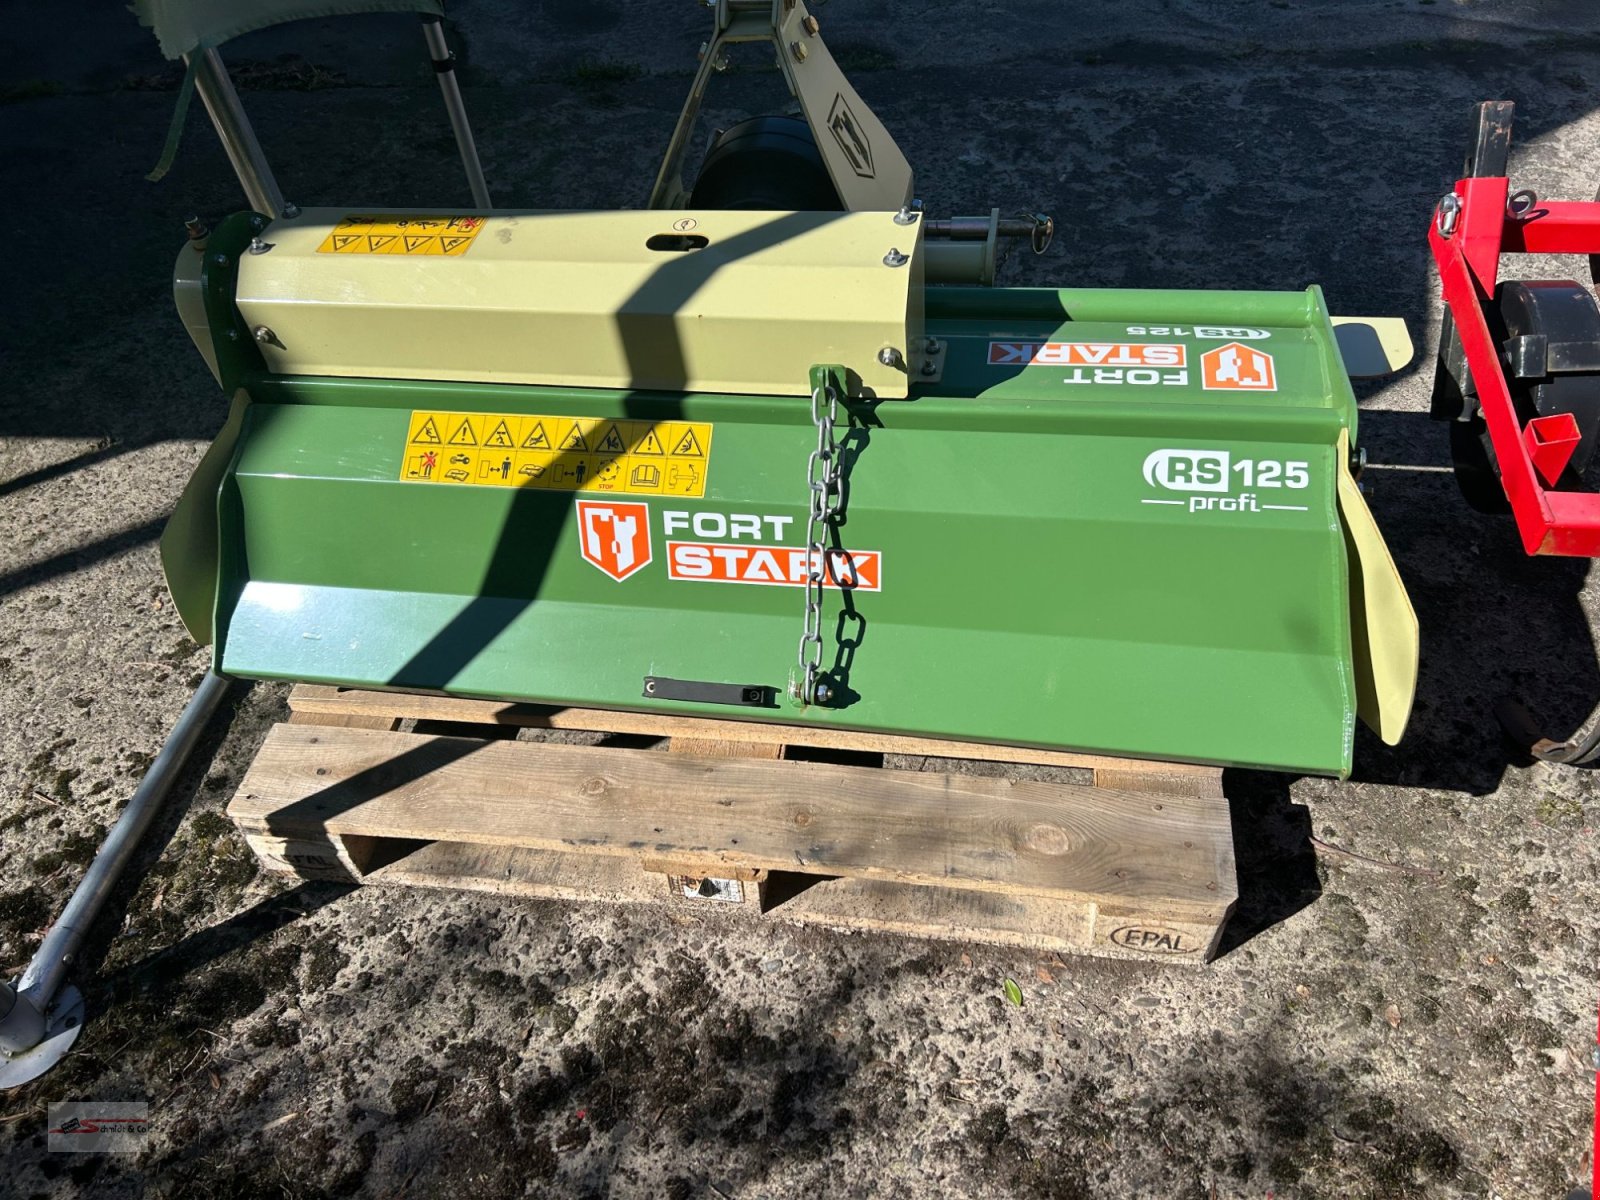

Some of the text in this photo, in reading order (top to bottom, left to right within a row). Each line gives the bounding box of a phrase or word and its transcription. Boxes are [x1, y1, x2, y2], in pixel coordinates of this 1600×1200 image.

[1126, 326, 1250, 338] RS 125
[997, 344, 1180, 365] STARK
[1063, 368, 1189, 386] FORT
[1166, 456, 1309, 489] RS 125
[1189, 493, 1261, 513] profi
[662, 510, 794, 541] FORT
[674, 546, 873, 586] STARK
[1124, 929, 1188, 953] EPAL
